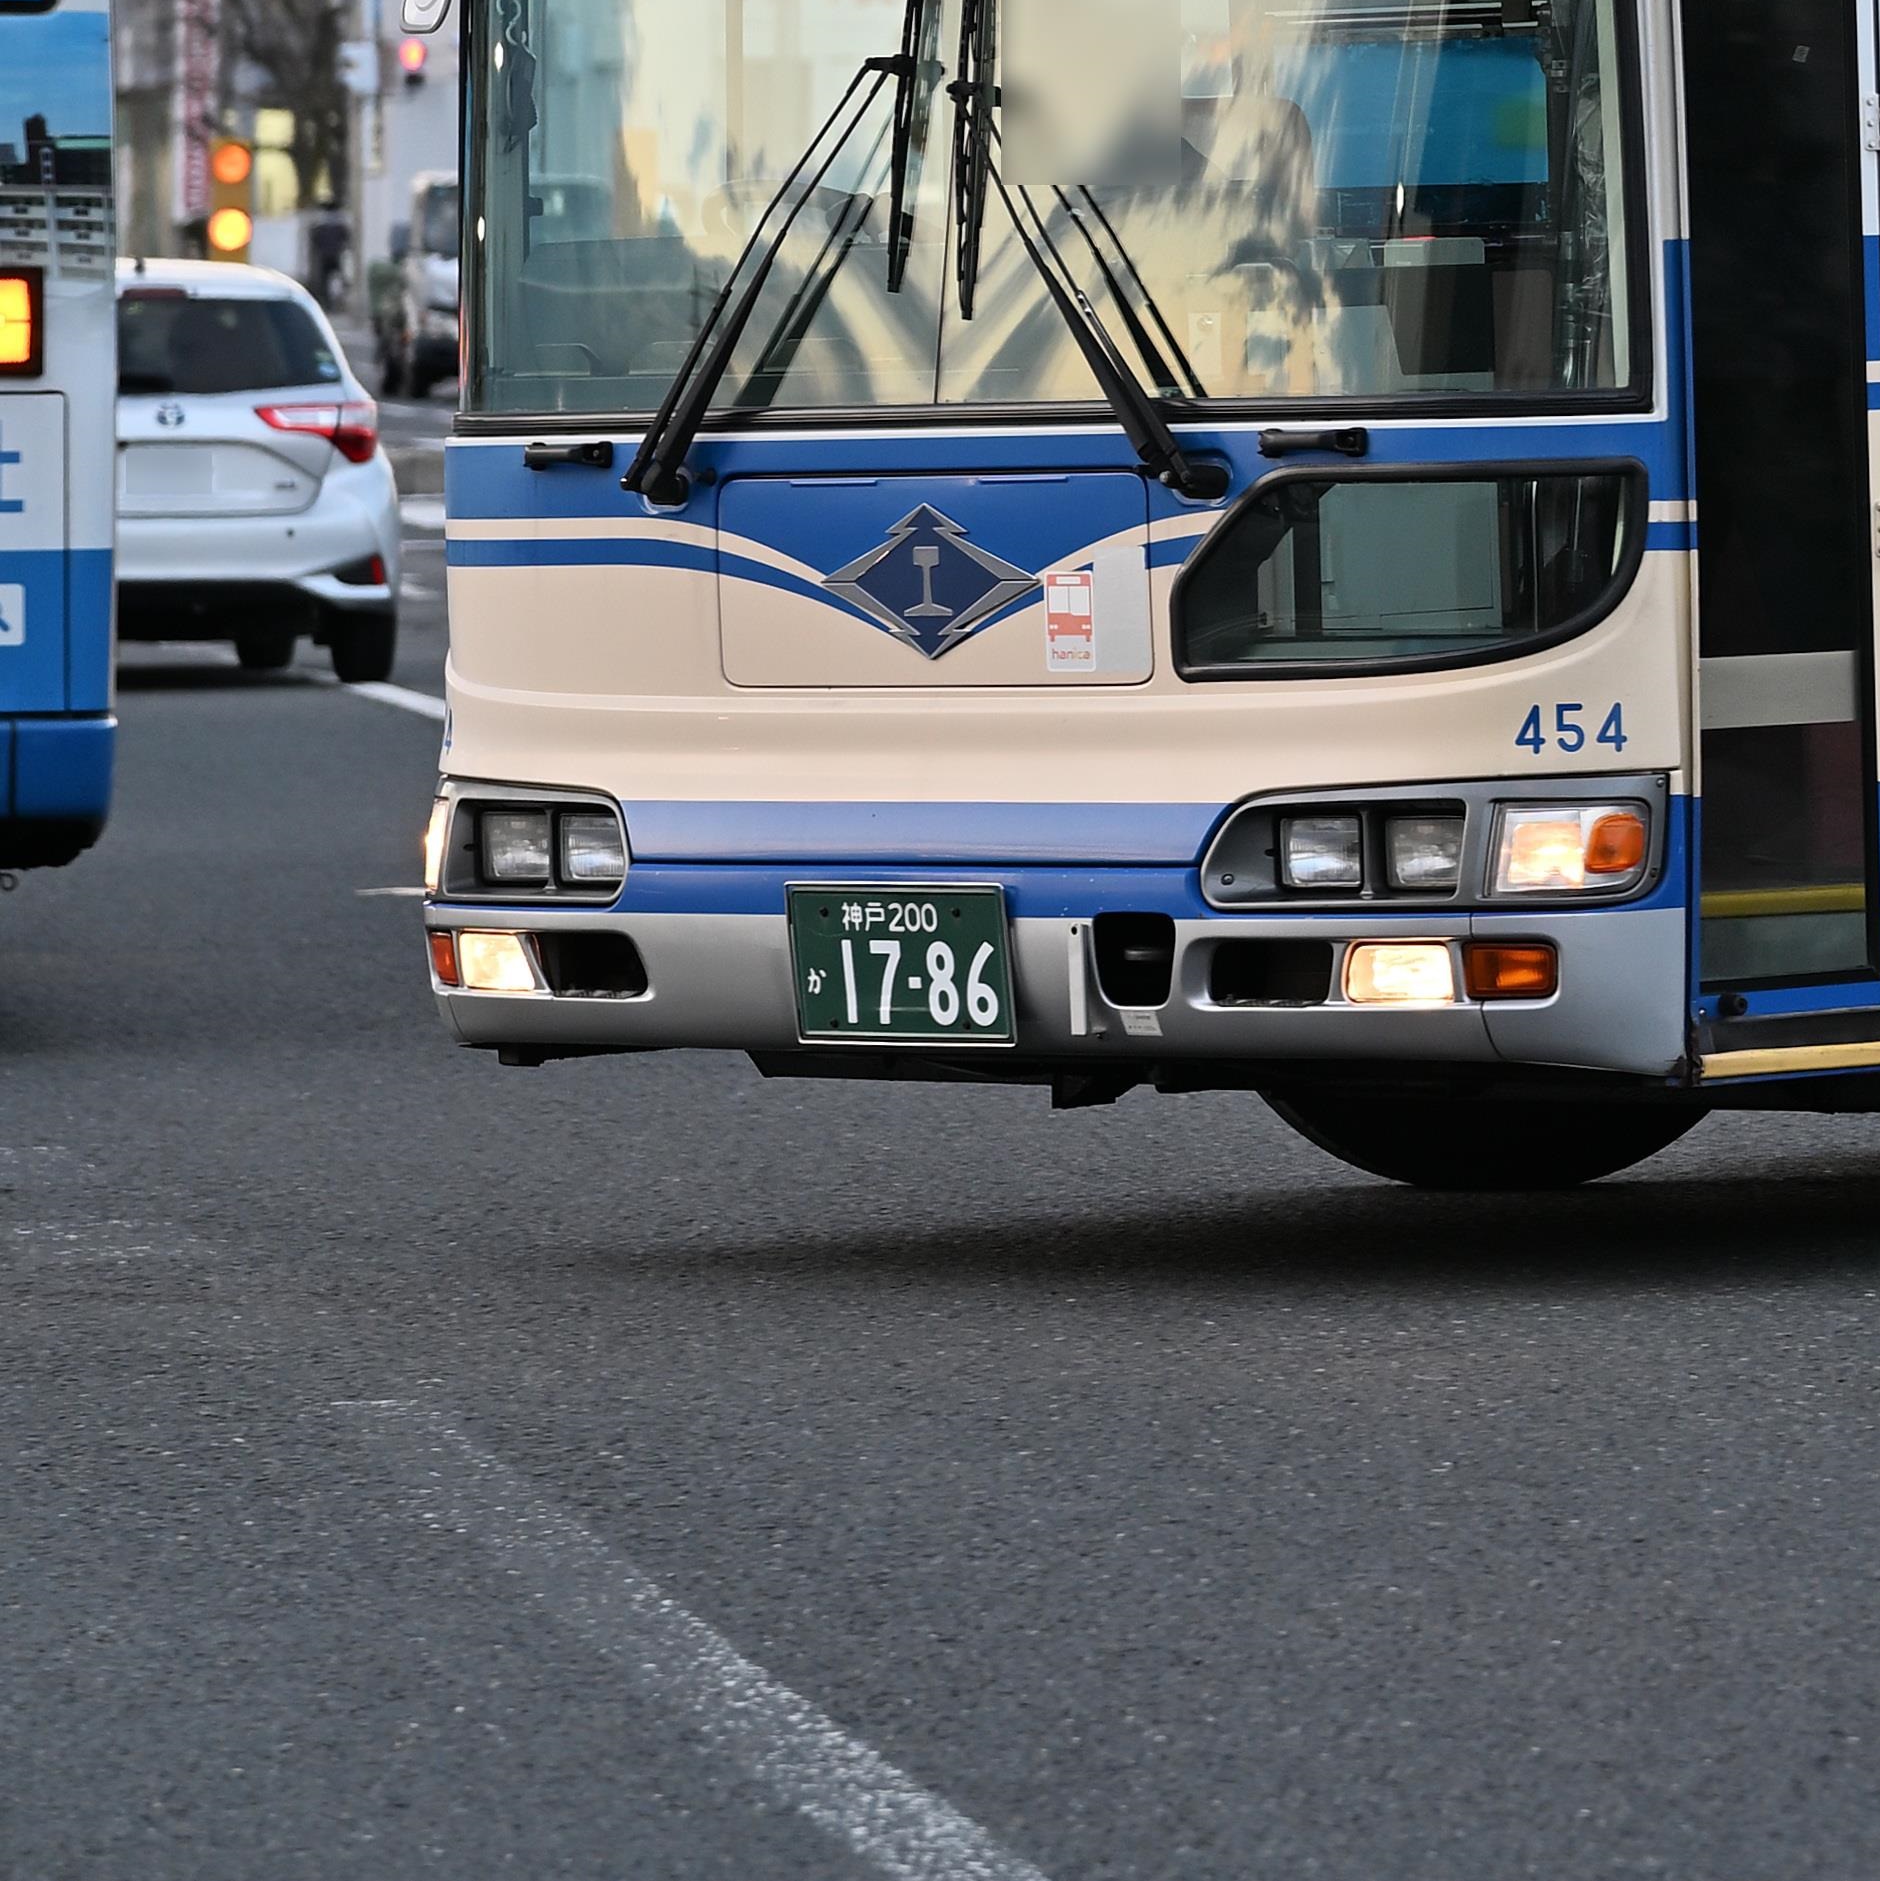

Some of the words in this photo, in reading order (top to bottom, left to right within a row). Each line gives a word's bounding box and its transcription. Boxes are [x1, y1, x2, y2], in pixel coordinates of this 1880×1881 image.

[1514, 702, 1628, 755] 454
[807, 967, 827, 995] か
[840, 939, 999, 1027] 17-86
